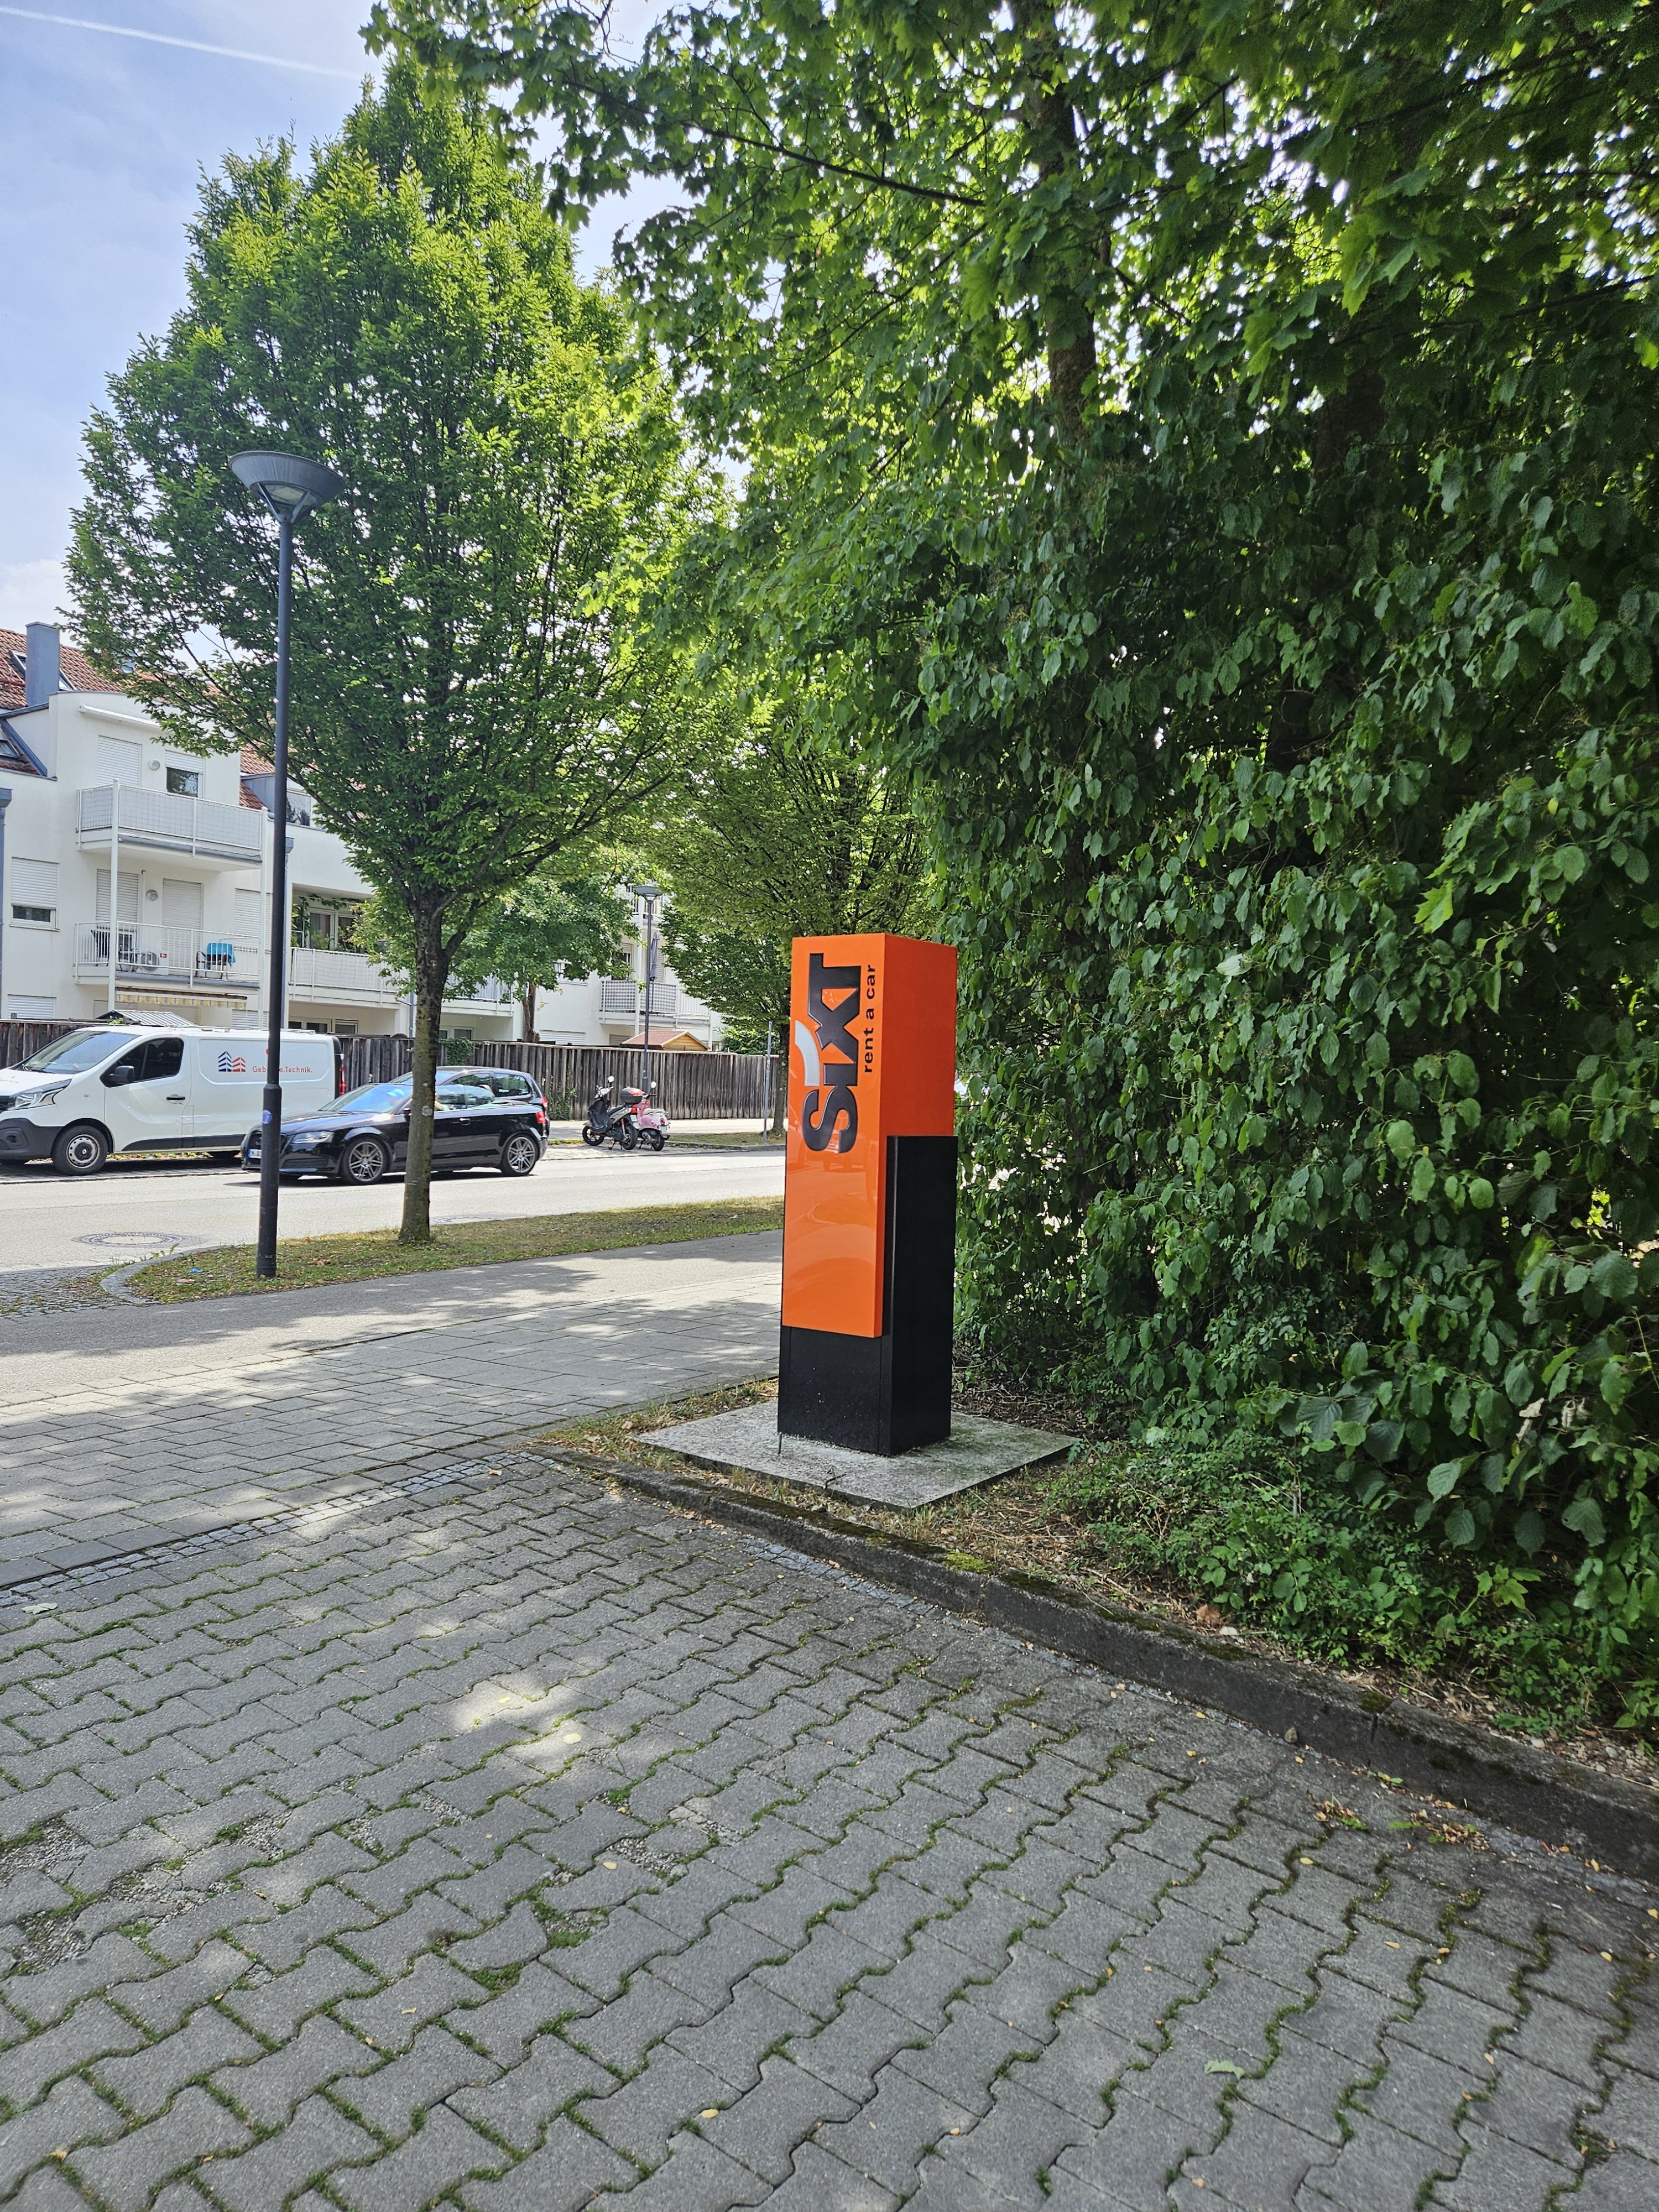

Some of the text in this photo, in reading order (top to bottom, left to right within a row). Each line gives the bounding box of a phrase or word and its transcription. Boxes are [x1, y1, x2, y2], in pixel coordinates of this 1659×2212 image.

[863, 964, 876, 1073] rent a car
